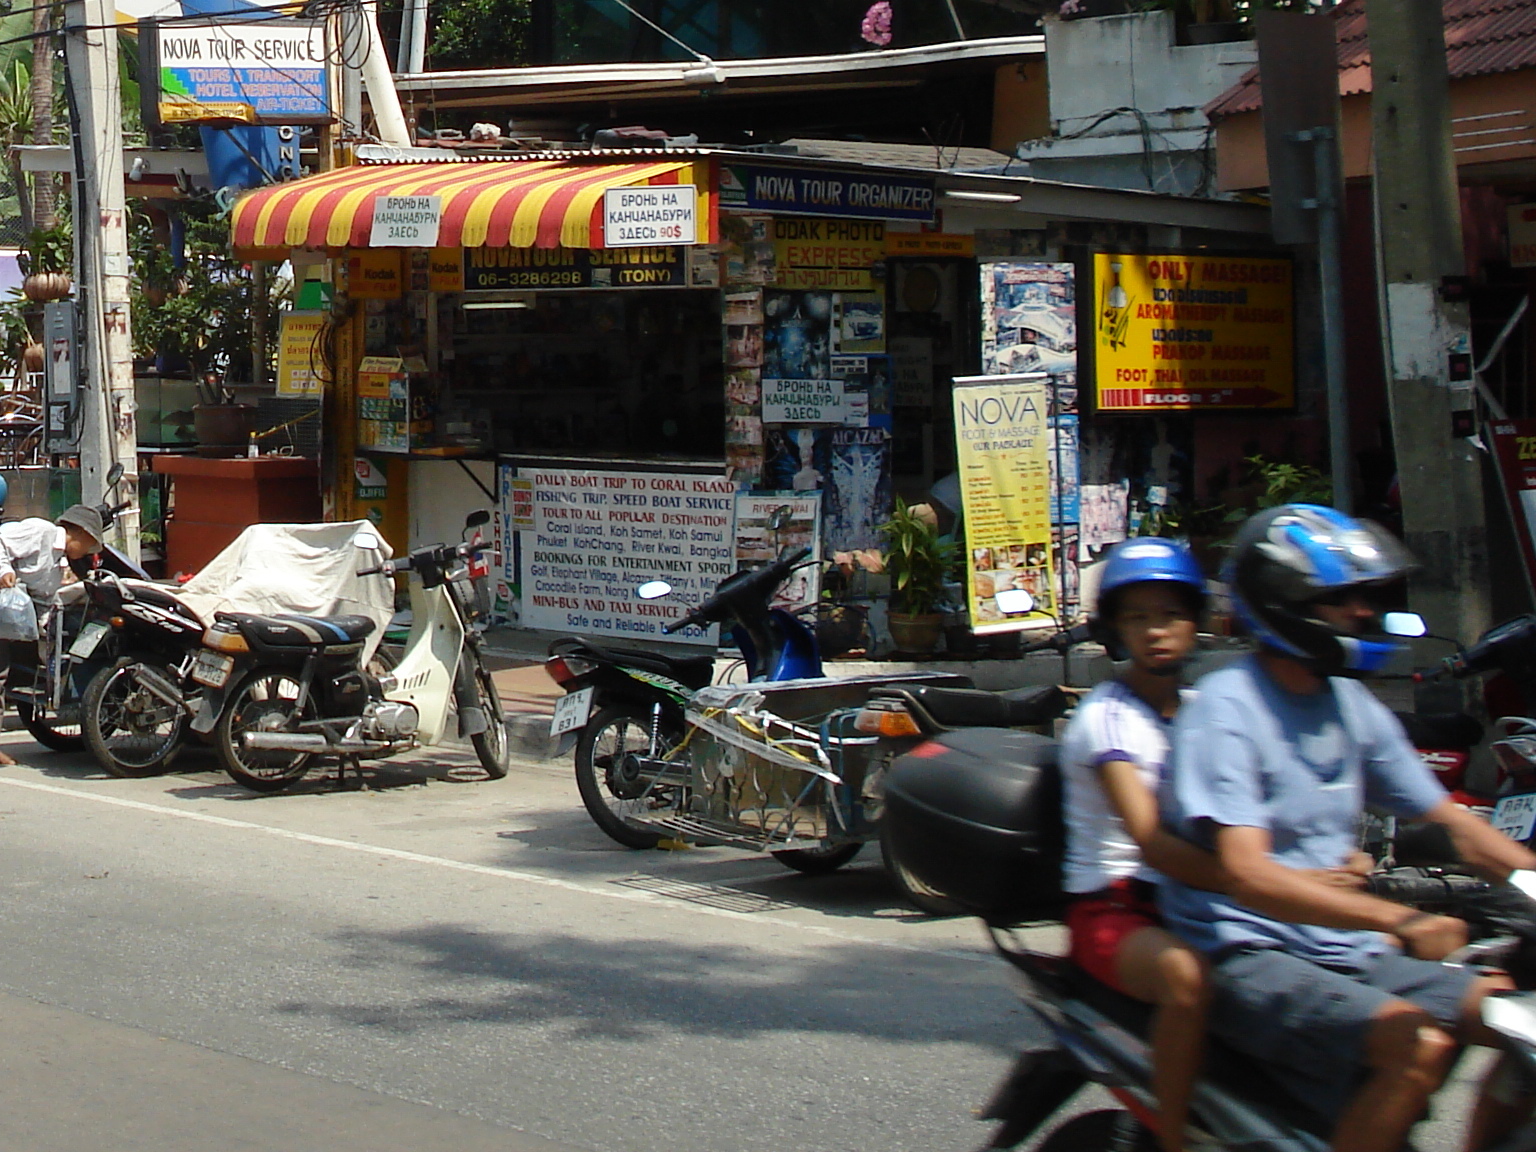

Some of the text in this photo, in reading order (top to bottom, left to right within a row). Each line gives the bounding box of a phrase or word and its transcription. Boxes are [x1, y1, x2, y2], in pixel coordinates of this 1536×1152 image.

[163, 38, 316, 61] NOVA TOUR SERVICE
[188, 69, 231, 83] TOURS
[247, 69, 321, 83] TRANSPORT
[195, 83, 322, 98] HOTEL RESERVATION
[256, 98, 321, 111] AIR-TICKET
[621, 193, 678, 207] БРОНЬ НА
[755, 175, 933, 211] NOVA TOUR ORGANIZER
[387, 197, 430, 210] БРОНЬ НА
[619, 224, 682, 240] ЗДЕСЬ 90$
[825, 221, 884, 241] PHOTO
[589, 248, 676, 266] SERVICE
[787, 246, 872, 266] EXPRESS
[364, 268, 395, 280] Kodak
[432, 263, 458, 274] Kodak
[478, 268, 671, 286] 06-3286298 (TONY)
[1148, 260, 1195, 282] ONLY
[777, 381, 832, 394] БРОНЬ НА
[1144, 393, 1203, 404] FLOOR
[784, 407, 821, 420] ЗДЕСЬ
[961, 396, 1040, 426] NOVA
[961, 428, 986, 441] FOOT
[998, 425, 1041, 438] MASSAGE
[535, 474, 567, 487] DAILY
[570, 476, 598, 488] BOAT
[603, 477, 627, 490] TRIP
[631, 478, 646, 490] TO
[651, 479, 688, 492] CORAL
[693, 481, 734, 494] ISLAND
[536, 490, 577, 503] FISHING
[613, 493, 647, 506] SPEED
[652, 495, 680, 508] BOAT
[685, 497, 732, 510] SERVICE
[500, 465, 513, 579] PRIVATE
[542, 507, 727, 527] TOUR TO ALL POPULAR DESTINATION
[547, 521, 572, 534] Coral
[610, 525, 628, 537] Koh
[669, 528, 687, 540] Koh
[690, 529, 723, 542] Samui
[537, 534, 567, 548] Phuket
[632, 537, 655, 552] River
[534, 551, 583, 565] BOOKINGS
[588, 554, 607, 567] FOR
[613, 556, 692, 573] ENTERTAINMENT
[552, 566, 587, 582] Elephant
[535, 580, 576, 594] Crocodile
[605, 586, 629, 601] Nong
[532, 595, 680, 618] MINI-BUS AND TAXI SERVICE
[567, 614, 589, 627] Safe
[592, 616, 612, 629] and
[615, 619, 655, 633] Reliable
